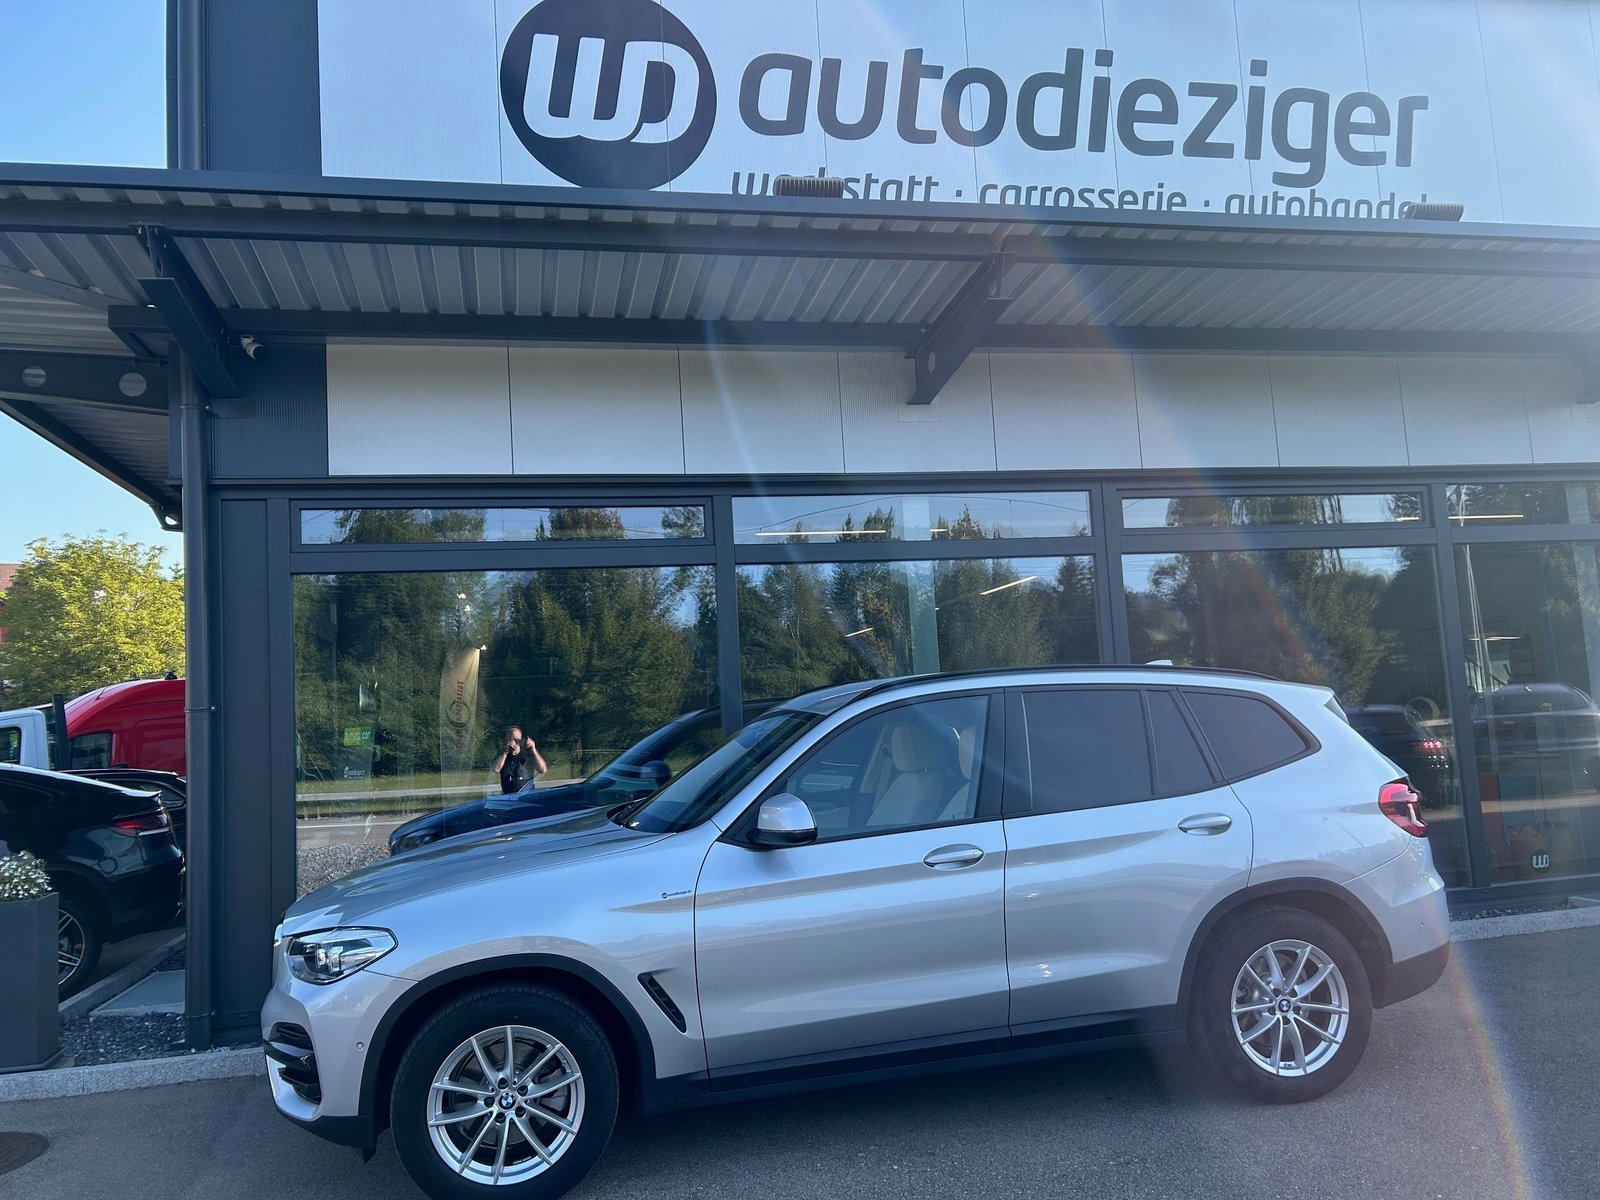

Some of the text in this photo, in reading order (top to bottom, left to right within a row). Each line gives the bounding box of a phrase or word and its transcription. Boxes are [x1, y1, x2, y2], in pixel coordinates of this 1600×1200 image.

[739, 47, 1430, 189] autodieziger
[732, 167, 1428, 220] wstatt carrosserie autohand
